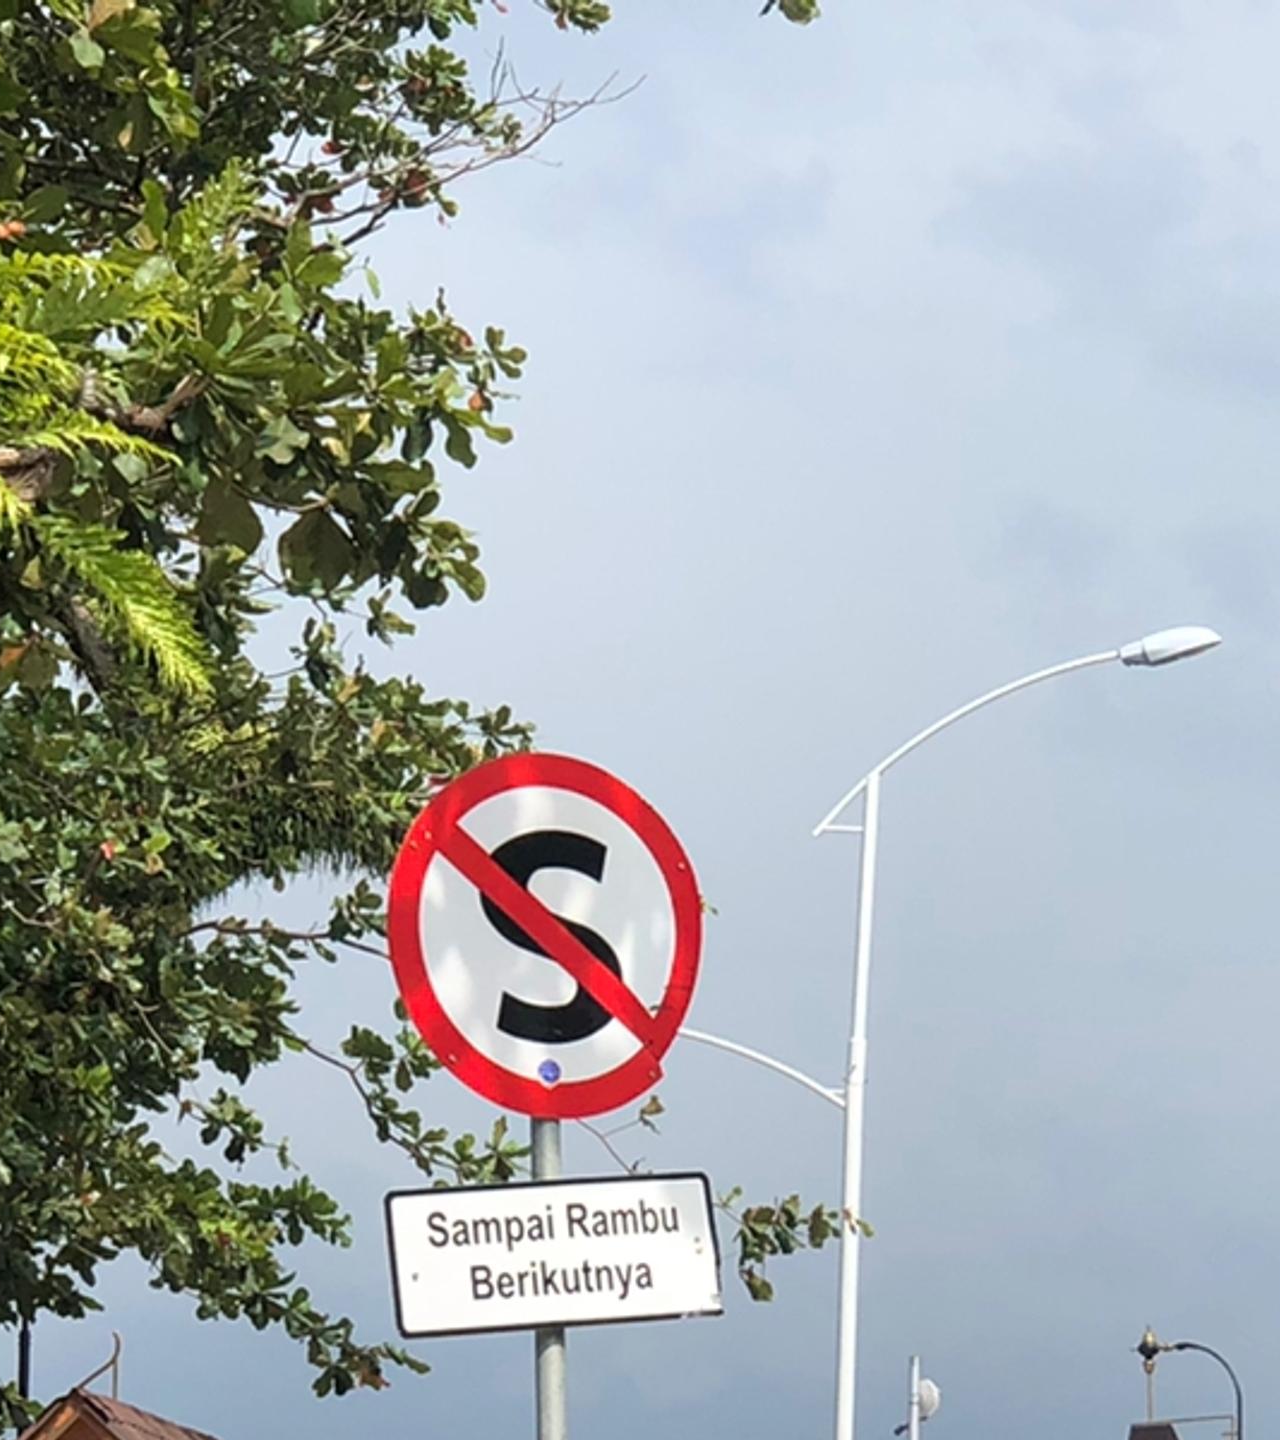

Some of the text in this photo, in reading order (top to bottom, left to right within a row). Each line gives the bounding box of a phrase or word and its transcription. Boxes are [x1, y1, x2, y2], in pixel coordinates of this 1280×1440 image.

[480, 828, 622, 1045] S
[426, 1199, 680, 1252] Sampai Rambu
[470, 1259, 654, 1301] Berikutnya
